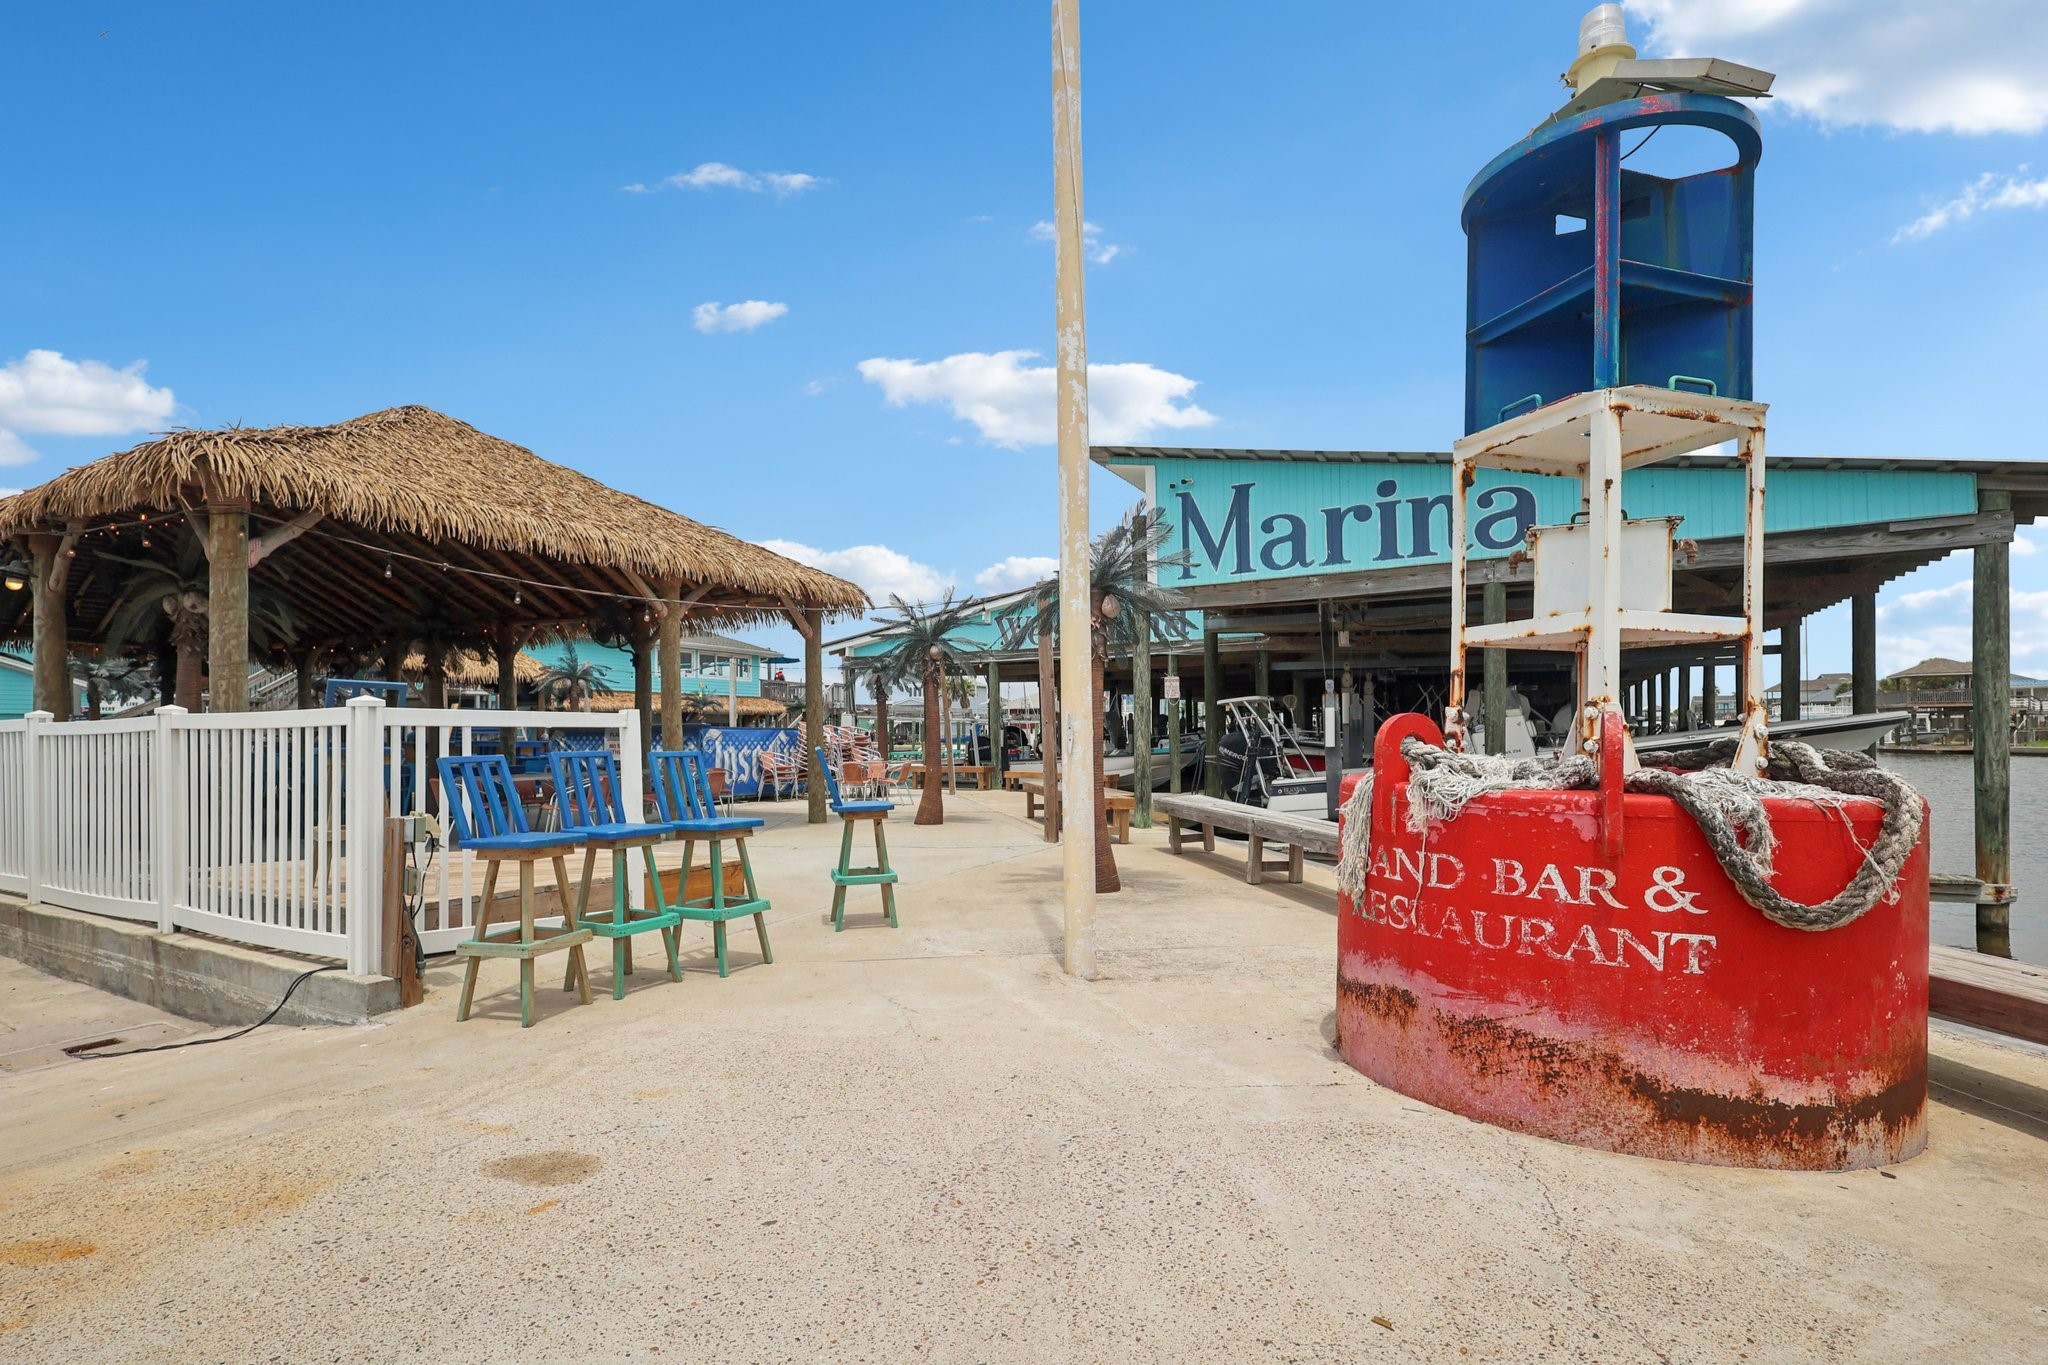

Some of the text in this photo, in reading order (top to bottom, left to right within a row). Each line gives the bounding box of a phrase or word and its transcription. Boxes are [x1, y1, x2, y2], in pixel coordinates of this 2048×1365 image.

[1175, 479, 1538, 580] Marina
[1491, 857, 1629, 910] BAR
[1644, 865, 1709, 916] &
